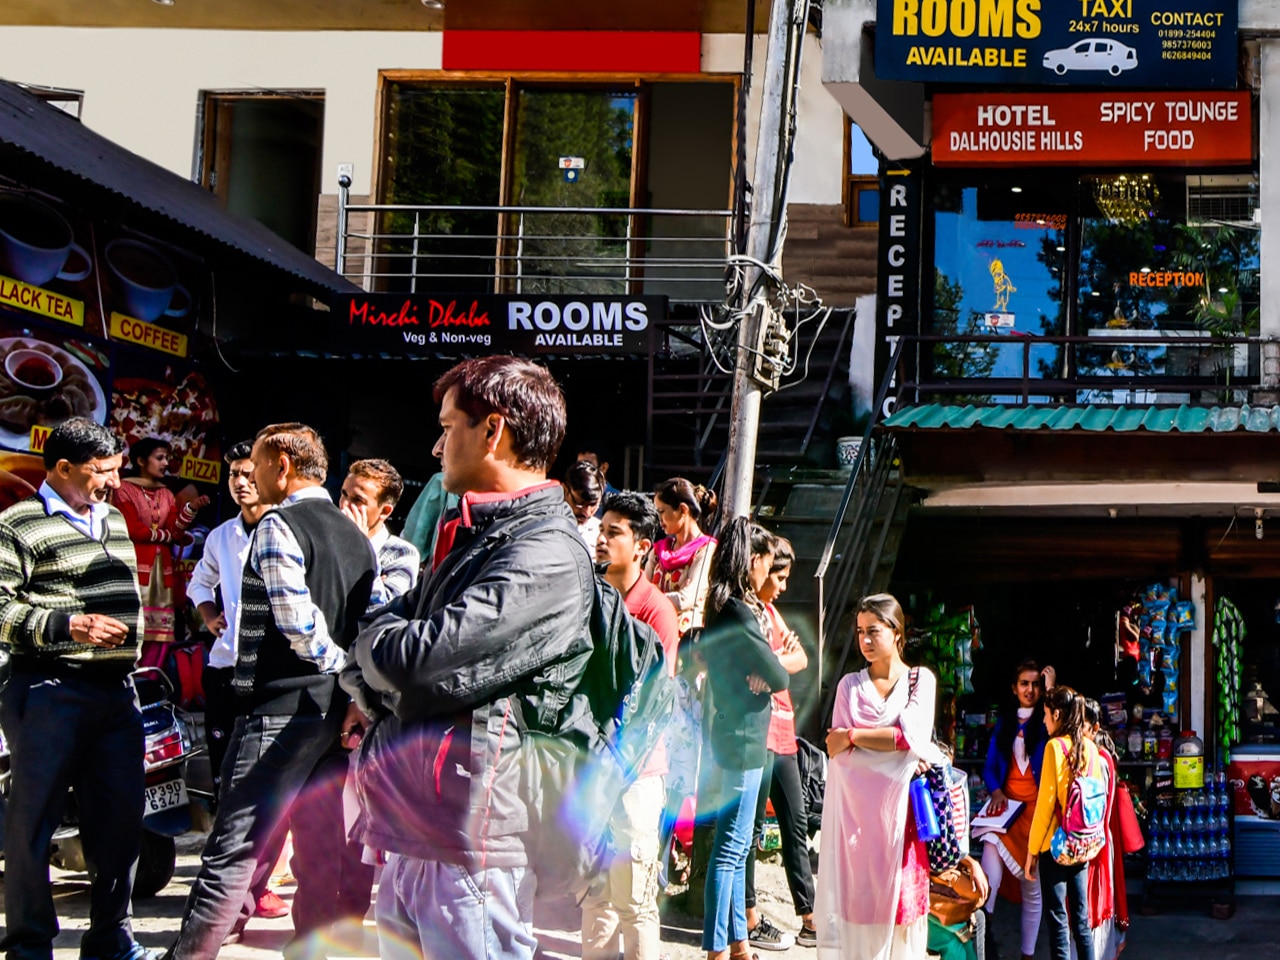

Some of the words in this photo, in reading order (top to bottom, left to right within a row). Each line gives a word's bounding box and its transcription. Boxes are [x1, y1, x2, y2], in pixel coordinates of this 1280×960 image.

[1068, 19, 1099, 34] 24x7
[1102, 20, 1140, 34] hours
[1150, 11, 1224, 27] CONTACT
[905, 46, 1028, 68] AVAILABLE
[977, 104, 1056, 127] HOTEL
[1100, 101, 1156, 124] SPICY
[1164, 99, 1238, 124] TOUNGE
[950, 130, 1036, 152] DALHOUSIE
[1040, 130, 1083, 151] HILLS
[1144, 129, 1195, 152] FOOD
[1129, 271, 1205, 287] RECEPTION
[46, 295, 74, 320] TEA
[349, 298, 420, 328] Mirchi
[428, 299, 491, 329] Dhaba
[507, 301, 649, 331] ROOMS
[120, 318, 180, 353] COFFEE
[403, 331, 427, 346] Veg
[428, 331, 438, 344] &
[440, 331, 492, 346] Non-veg
[534, 333, 624, 347] AVAILABLE
[185, 459, 218, 481] PIZZA
